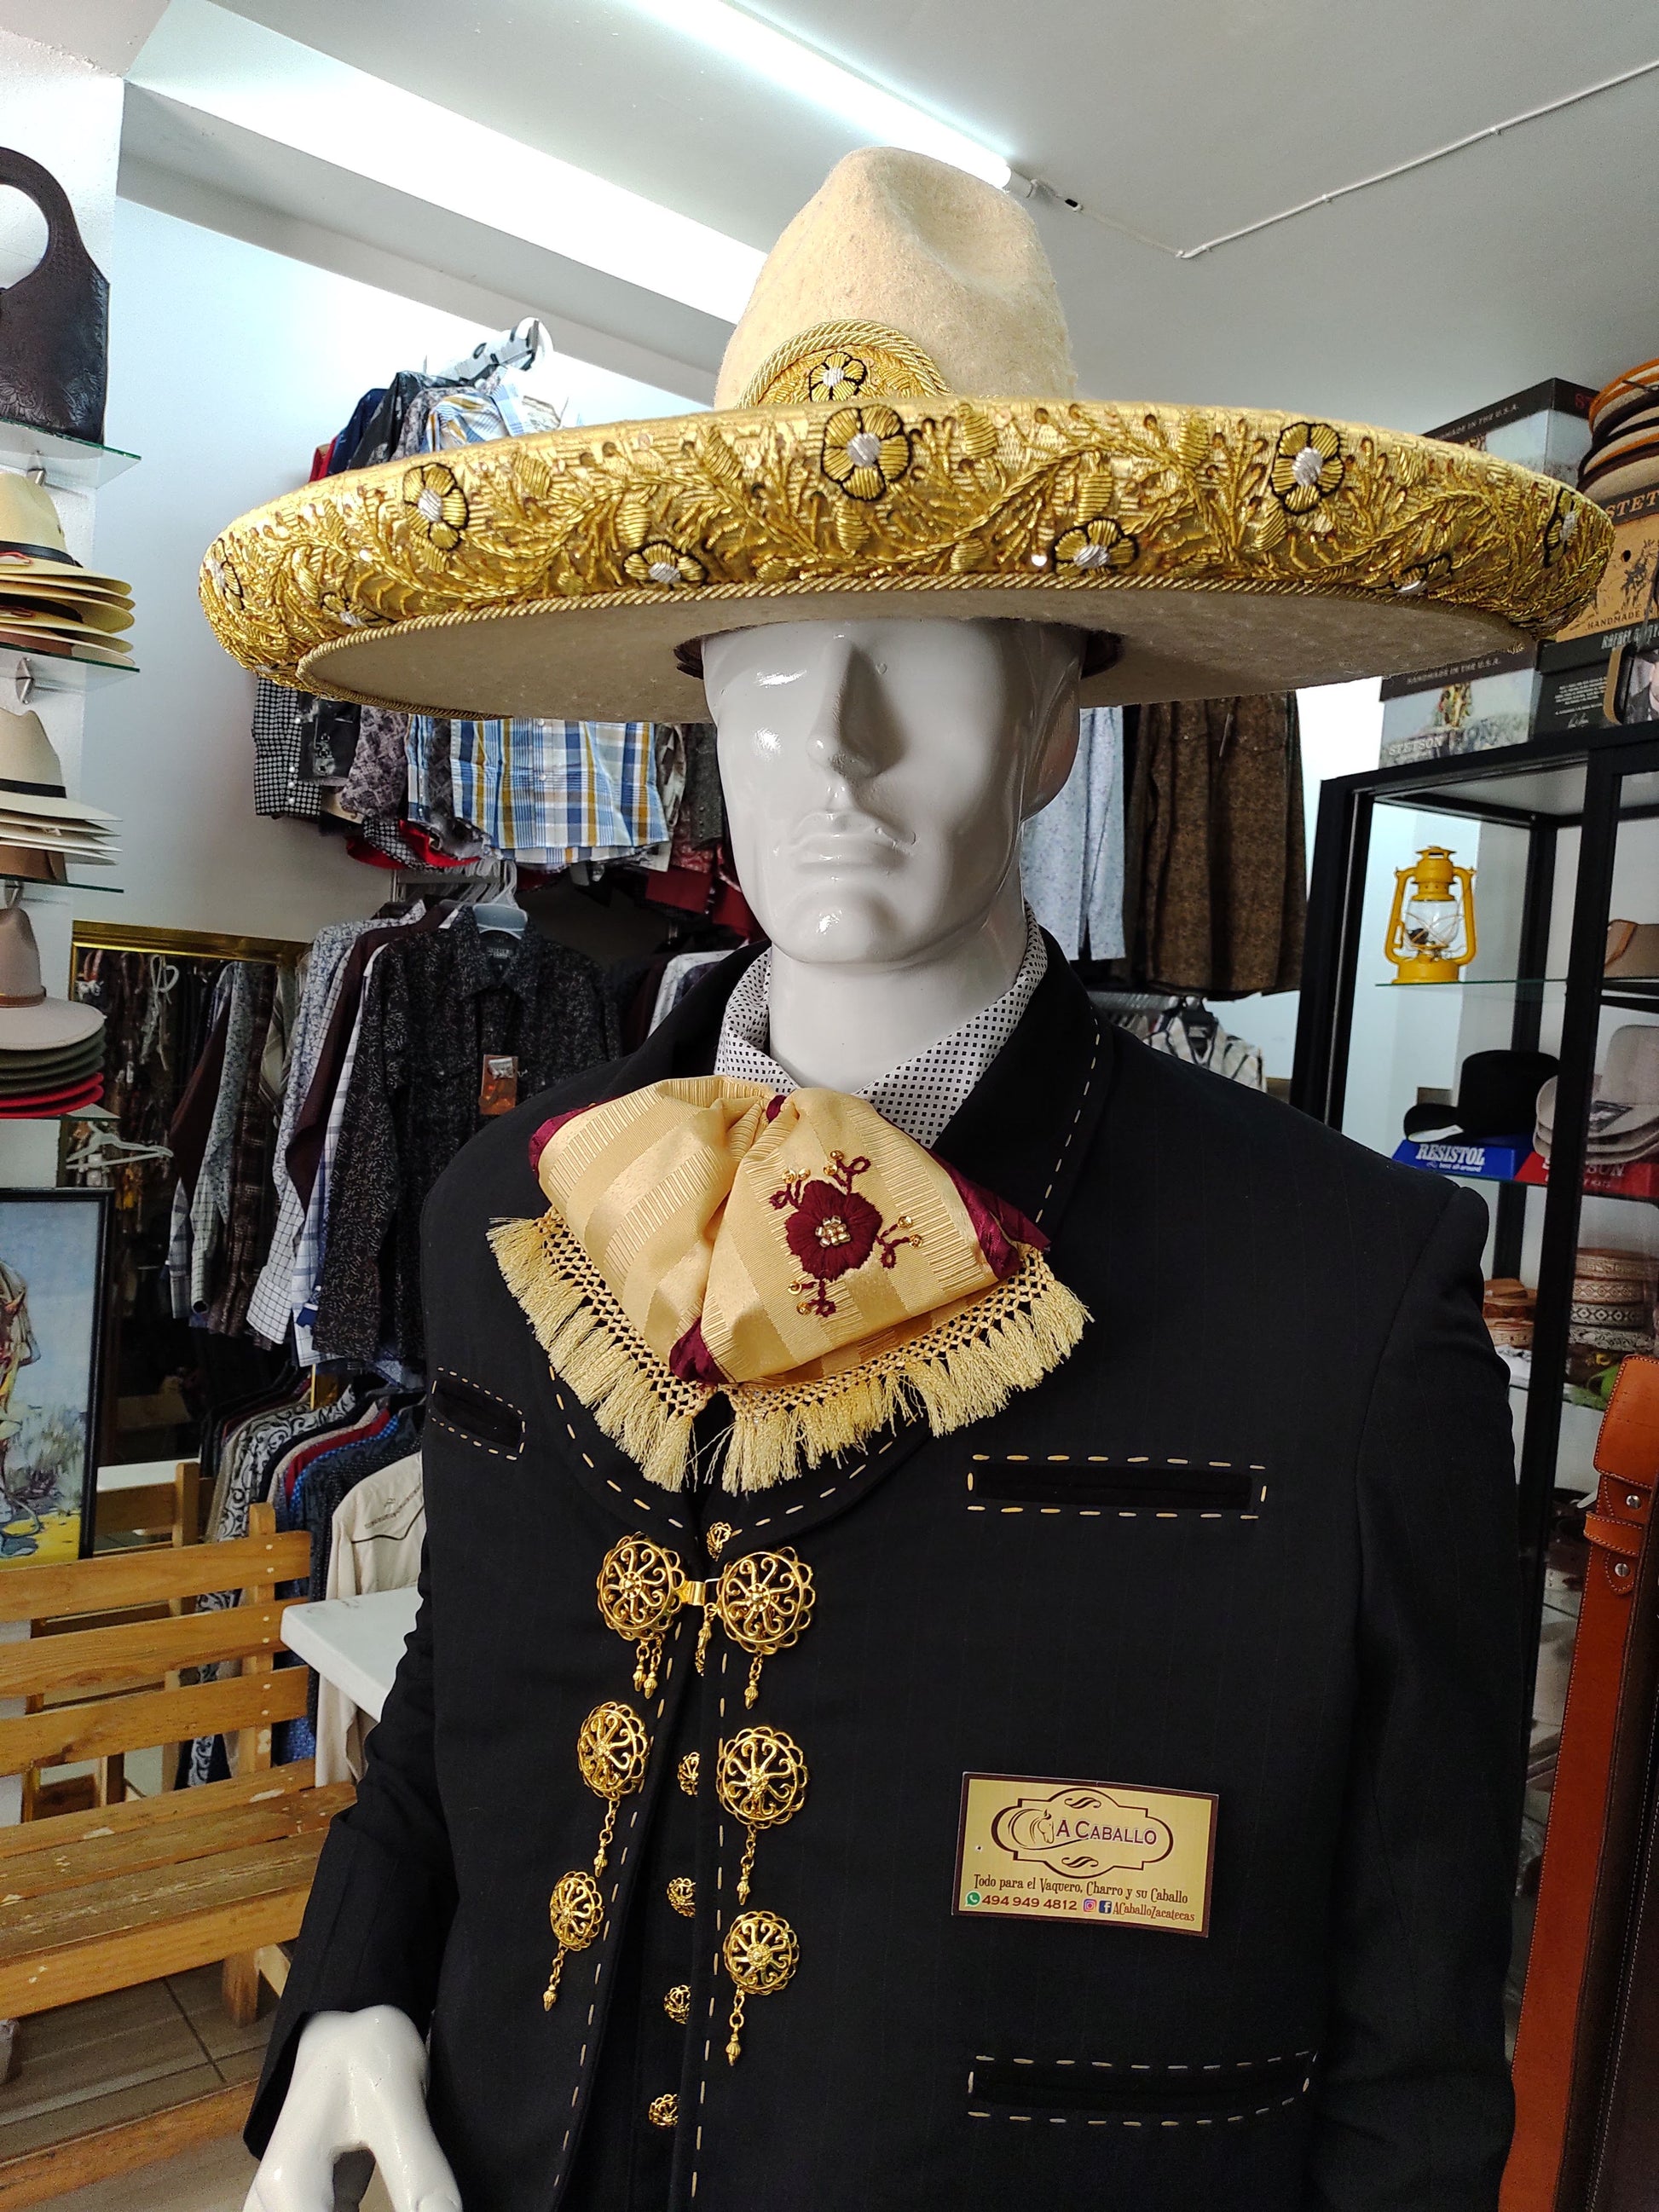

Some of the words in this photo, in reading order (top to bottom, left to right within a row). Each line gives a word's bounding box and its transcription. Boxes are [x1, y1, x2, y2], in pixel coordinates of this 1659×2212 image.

[1587, 609, 1641, 631] HANDMADE
[1389, 735, 1444, 756] STETSON
[1415, 1143, 1485, 1166] RESISTOL
[1055, 1819, 1071, 1838] A
[1075, 1820, 1157, 1845] CABALLO
[974, 1874, 997, 1889] Todo
[999, 1878, 1024, 1891] para
[1026, 1877, 1037, 1890] el
[1039, 1878, 1083, 1894] Vaquero,
[1086, 1880, 1124, 1897] Charro
[1124, 1888, 1133, 1900] y
[1136, 1889, 1148, 1899] su
[1150, 1887, 1188, 1904] Caballo
[981, 1895, 1009, 1906] 494
[1012, 1897, 1040, 1908] 949
[1043, 1898, 1078, 1911] 4812
[1112, 1901, 1195, 1922] ACaballoZacatecas
